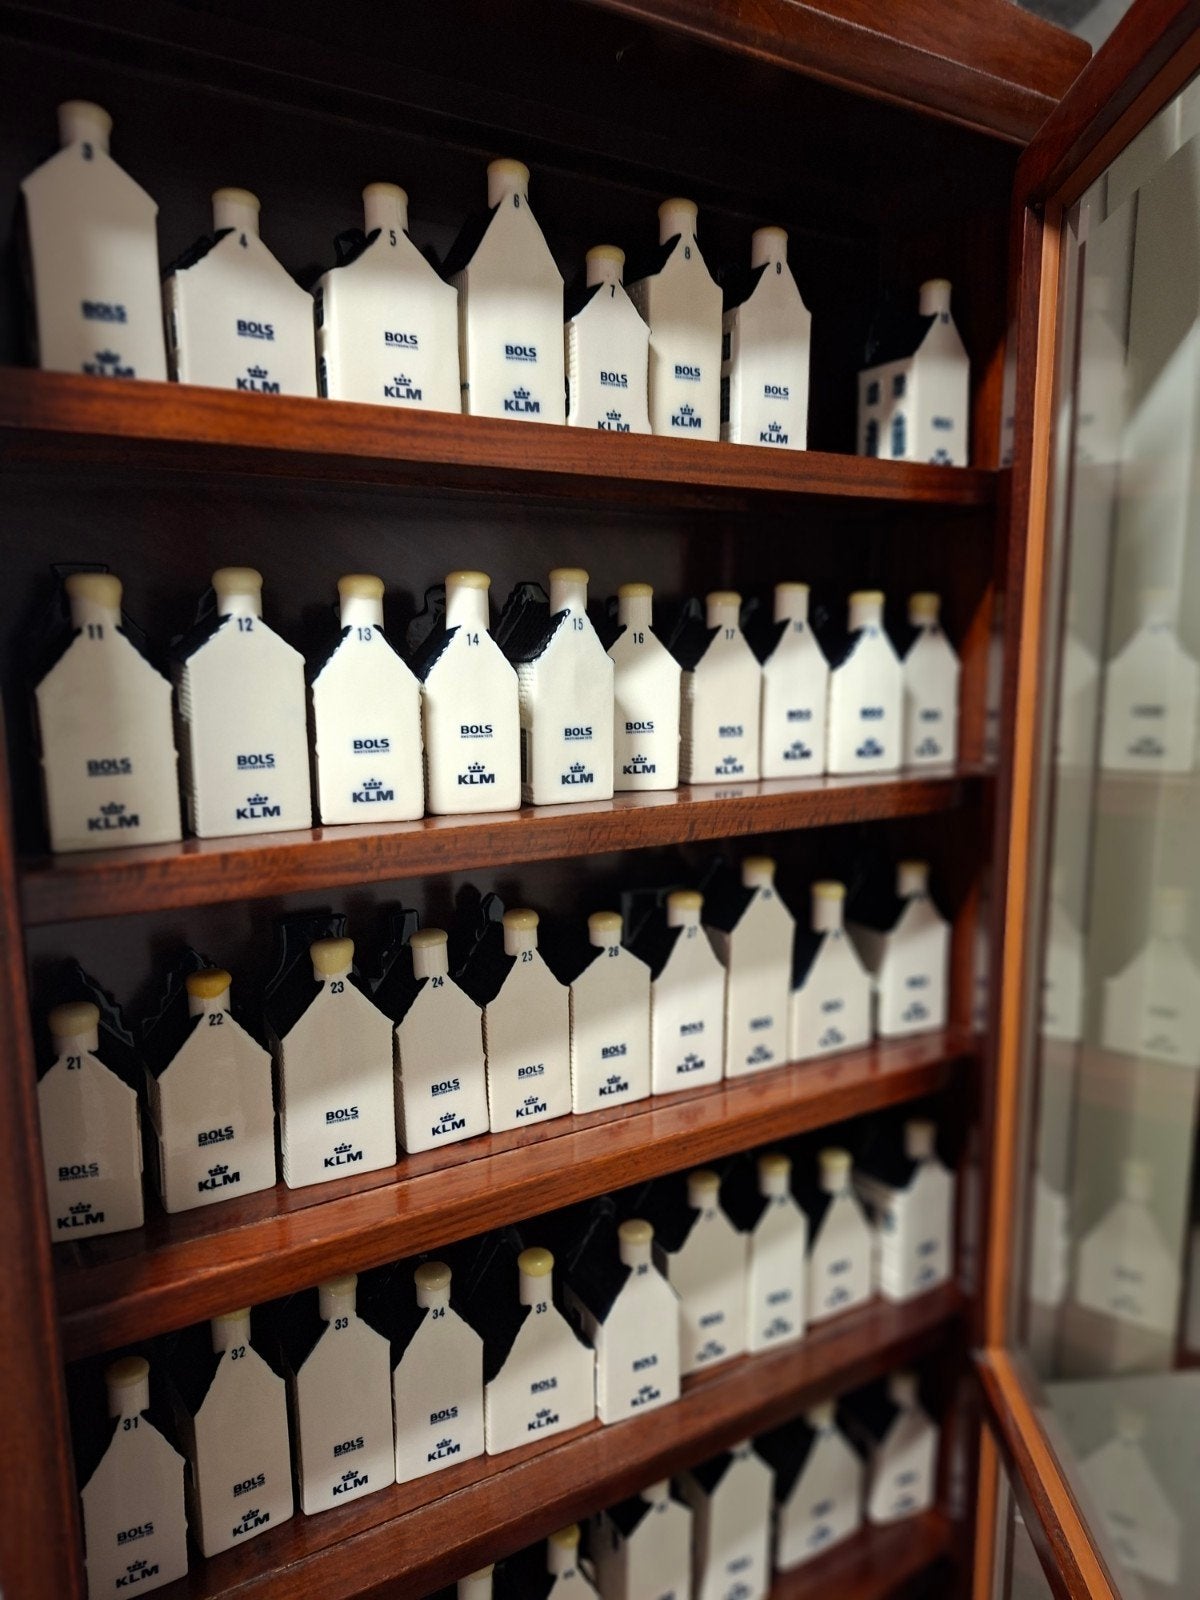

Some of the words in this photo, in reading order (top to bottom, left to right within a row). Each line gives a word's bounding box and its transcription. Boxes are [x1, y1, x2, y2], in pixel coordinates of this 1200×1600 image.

[513, 193, 520, 208] 6
[239, 233, 248, 249] 4
[389, 230, 397, 247] 5
[684, 246, 691, 260] 8
[776, 261, 782, 275] 9
[610, 284, 615, 298] 7
[236, 320, 275, 337] BOLS
[384, 331, 418, 345] BOLS
[505, 345, 537, 359] BOLS
[600, 371, 628, 385] BOLS
[674, 365, 701, 378] BOLS
[236, 377, 280, 395] KLM
[384, 385, 422, 401] KLM
[765, 384, 789, 397] BOLS
[504, 399, 540, 414] KLM
[597, 420, 630, 433] KLM
[671, 415, 702, 429] KLM
[760, 431, 789, 445] KLM
[237, 617, 254, 632] 12
[572, 618, 584, 631] 15
[88, 624, 103, 640] 11
[357, 627, 372, 642] 13
[632, 632, 645, 645] 16
[725, 628, 735, 640] 17
[466, 633, 480, 646] 14
[461, 724, 493, 735] BOLS
[564, 726, 593, 738] BOLS
[625, 721, 654, 732] BOLS
[718, 725, 744, 736] BOLS
[353, 738, 390, 750] BOLS
[87, 758, 131, 774] BOLS
[236, 753, 275, 767] BOLS
[622, 763, 656, 775] KLM
[715, 763, 744, 776] KLM
[458, 773, 496, 786] KLM
[561, 772, 594, 785] KLM
[352, 789, 394, 803] KLM
[236, 805, 281, 820] KLM
[87, 814, 140, 831] KLM
[521, 950, 533, 963] 25
[330, 981, 345, 994] 23
[431, 975, 444, 988] 24
[208, 1012, 224, 1026] 22
[601, 1043, 627, 1057] BOLS
[66, 1056, 82, 1070] 21
[677, 1059, 706, 1074] KLM
[518, 1064, 545, 1077] BOLS
[431, 1078, 460, 1094] BOLS
[599, 1081, 629, 1097] KLM
[326, 1106, 359, 1121] BOLS
[516, 1102, 547, 1118] KLM
[198, 1125, 234, 1142] BOLS
[431, 1118, 466, 1137] KLM
[324, 1150, 363, 1168] KLM
[58, 1162, 99, 1177] BOLS
[198, 1171, 241, 1192] KLM
[57, 1211, 105, 1229] KLM
[432, 1306, 445, 1319] 34
[535, 1302, 547, 1314] 35
[334, 1317, 349, 1330] 33
[231, 1346, 246, 1360] 32
[530, 1377, 558, 1392] BOLS
[430, 1406, 458, 1422] BOLS
[123, 1416, 139, 1431] 31
[527, 1414, 560, 1431] KLM
[333, 1436, 364, 1455] BOLS
[427, 1443, 461, 1462] KLM
[233, 1473, 265, 1494] BOLS
[332, 1474, 369, 1496] KLM
[232, 1512, 270, 1537] KLM
[117, 1522, 154, 1542] BOLS
[115, 1564, 160, 1589] KLM
